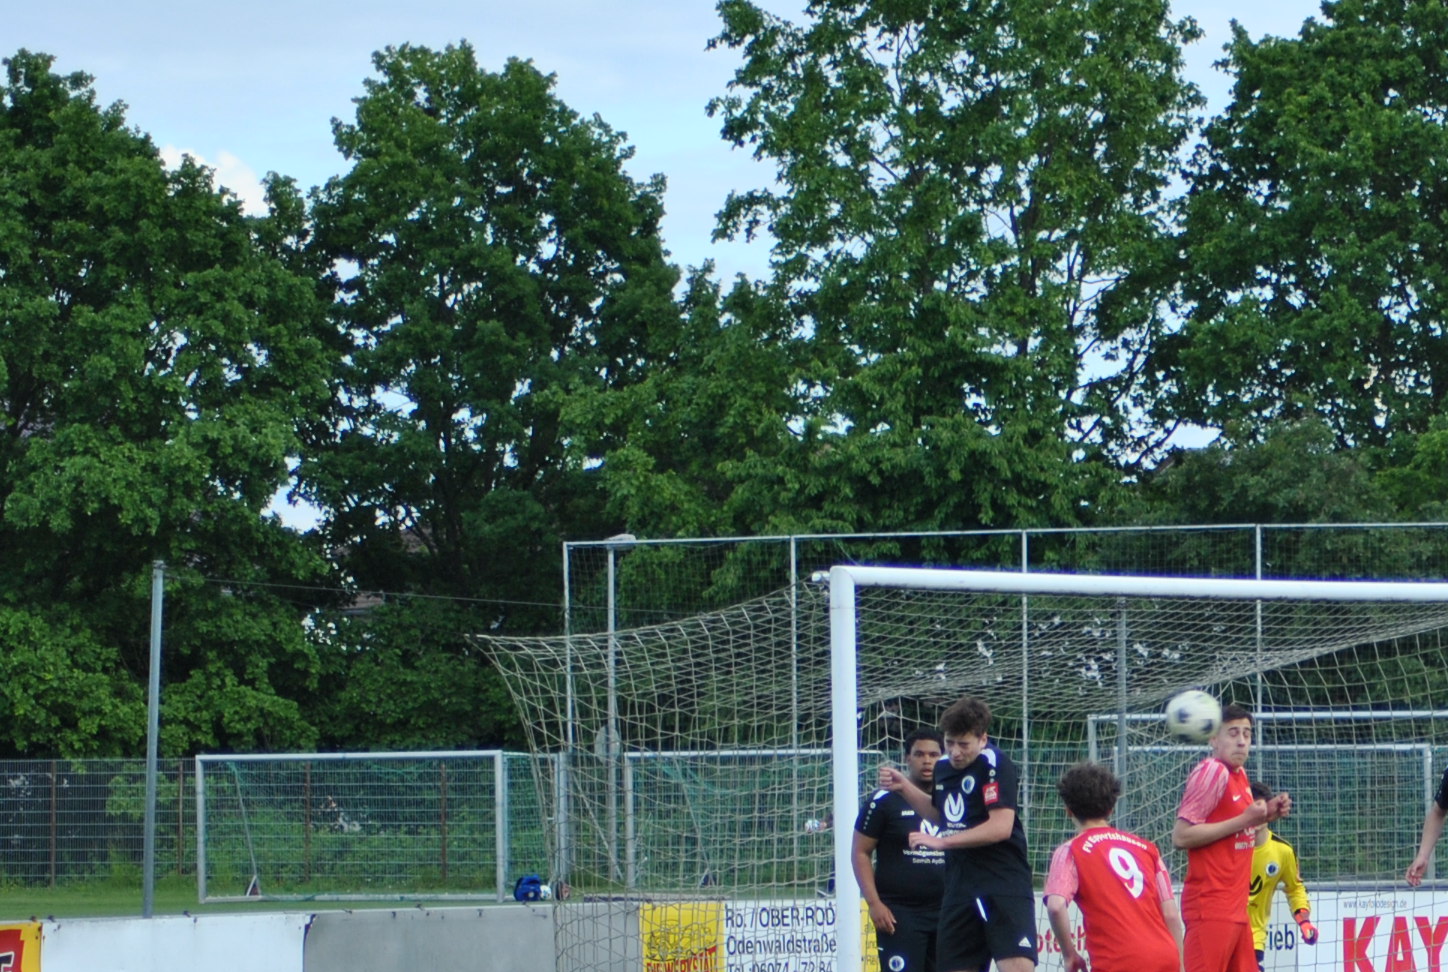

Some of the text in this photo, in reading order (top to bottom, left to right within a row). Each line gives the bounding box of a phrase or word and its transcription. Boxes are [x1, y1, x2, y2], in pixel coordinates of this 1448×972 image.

[1109, 847, 1144, 899] 9
[726, 933, 837, 955] Odenwaldstraße
[1266, 924, 1295, 951] ieb
